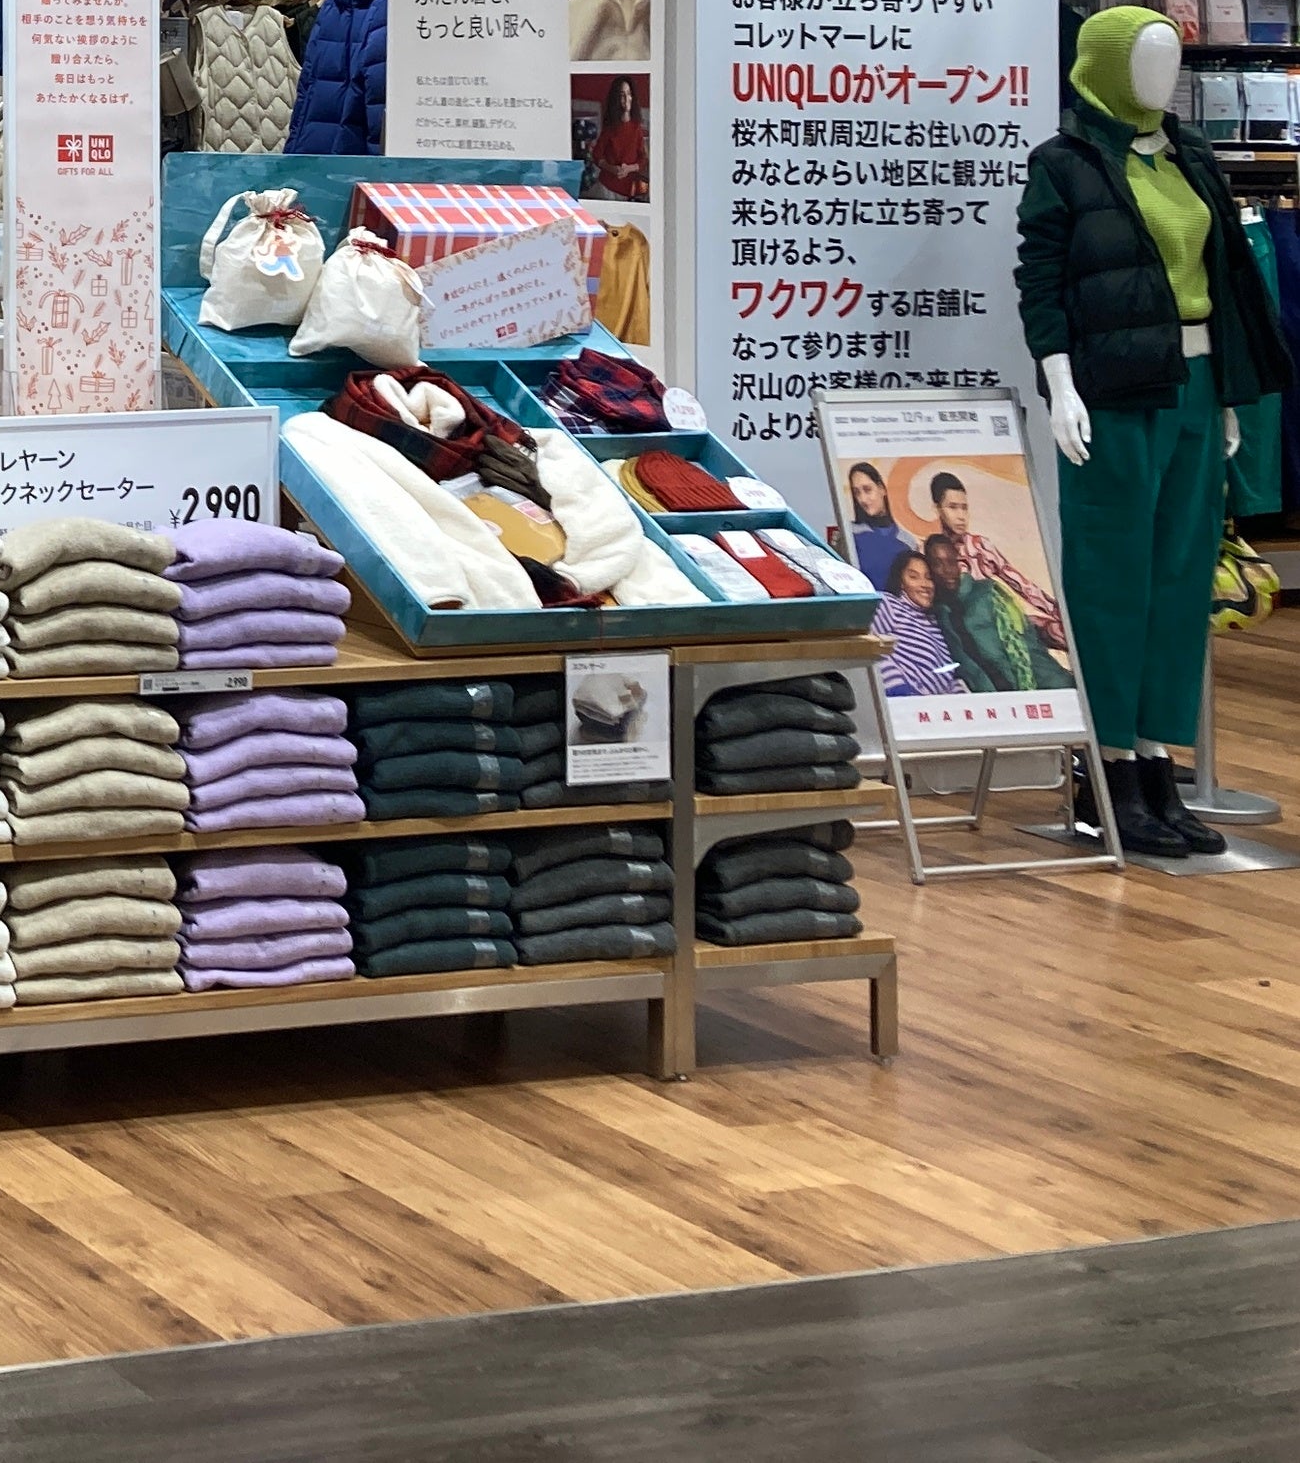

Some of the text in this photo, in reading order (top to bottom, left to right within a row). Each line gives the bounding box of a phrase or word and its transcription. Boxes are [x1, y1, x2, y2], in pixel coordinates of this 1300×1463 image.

[415, 13, 546, 40] もっと良い服へ。
[733, 22, 913, 51] コレットマーレに
[54, 73, 115, 85] 毎日はもっと
[732, 63, 1030, 110] UNIQLOがオープン!!
[36, 92, 134, 105] あたたかくなるはず。
[90, 138, 111, 148] UNI
[731, 118, 1030, 150] 桜木町駅周辺にお住いの方、
[90, 149, 112, 161] QLO
[57, 167, 115, 176] GIFTS FOR ALL
[731, 158, 1027, 188] みなとみらい地区に観光に
[731, 197, 990, 227] 来られる方に立ち寄って
[731, 237, 858, 267] 頂けるよう、
[731, 279, 987, 320] ワクワクする店舗に
[731, 329, 911, 361] なって参ります!!
[918, 705, 1018, 723] MARNI
